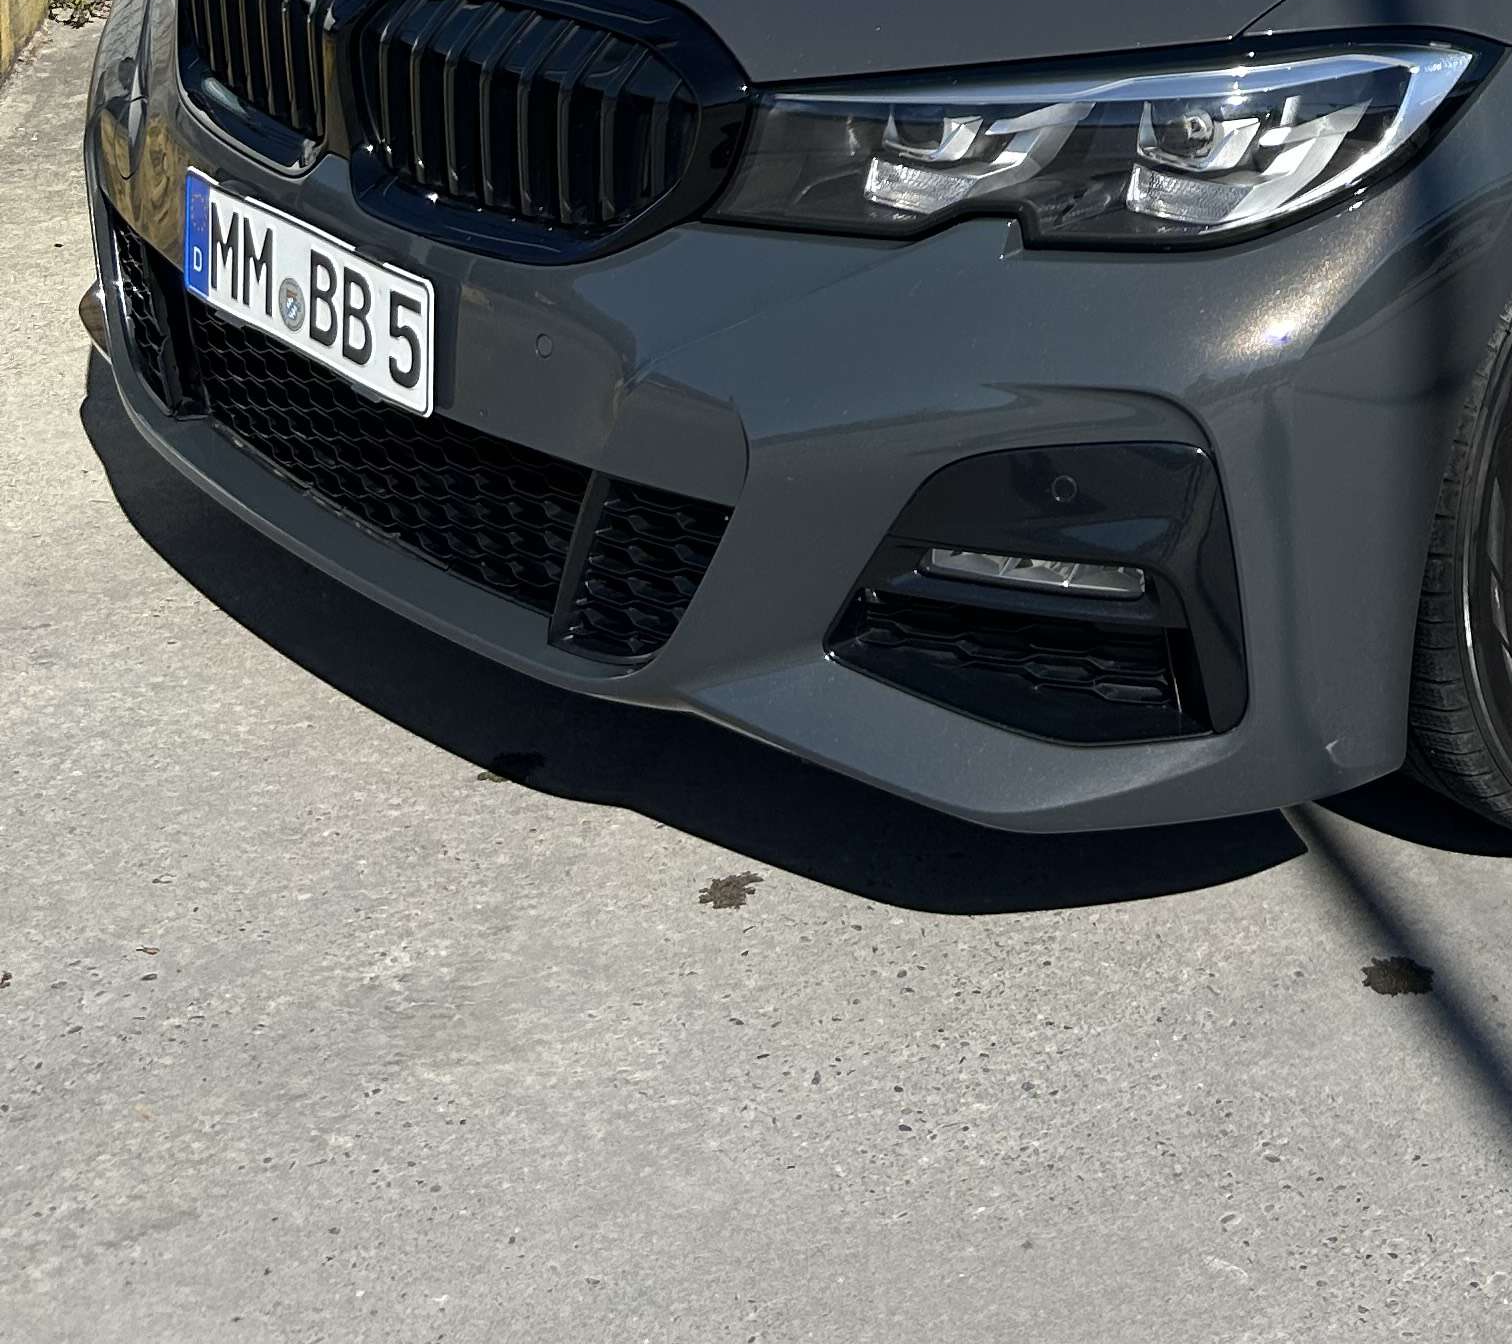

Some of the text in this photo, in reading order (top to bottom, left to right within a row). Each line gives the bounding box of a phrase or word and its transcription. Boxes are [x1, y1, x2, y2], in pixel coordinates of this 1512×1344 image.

[193, 202, 422, 389] D MM BB 5
